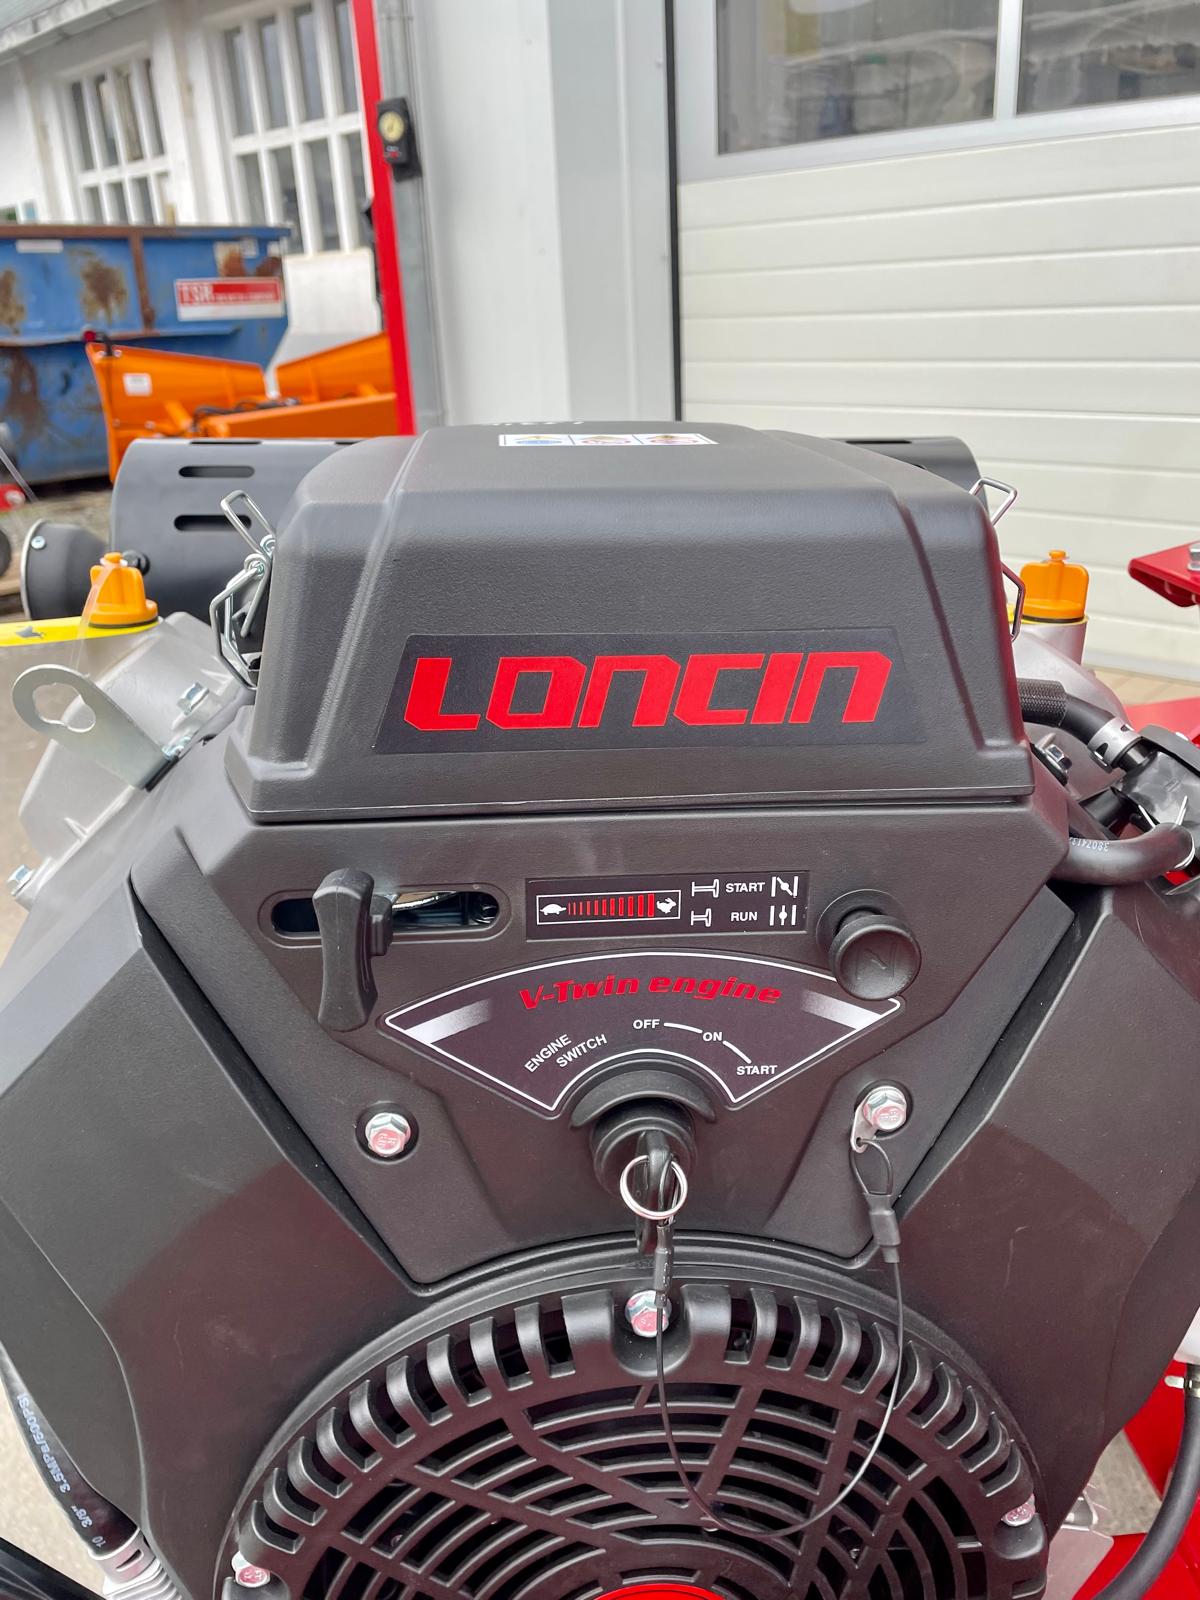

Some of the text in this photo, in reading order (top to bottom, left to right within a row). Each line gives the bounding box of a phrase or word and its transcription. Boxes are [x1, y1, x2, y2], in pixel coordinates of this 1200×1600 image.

[404, 651, 893, 731] LONCIN
[725, 881, 766, 893] START
[730, 911, 758, 922] RUN
[518, 974, 783, 1011] V-Twin engine
[632, 1018, 661, 1031] OFF
[702, 1031, 723, 1042] ON
[523, 1033, 573, 1074] ENGINE
[555, 1033, 608, 1069] SWITCH
[736, 1064, 778, 1076] START
